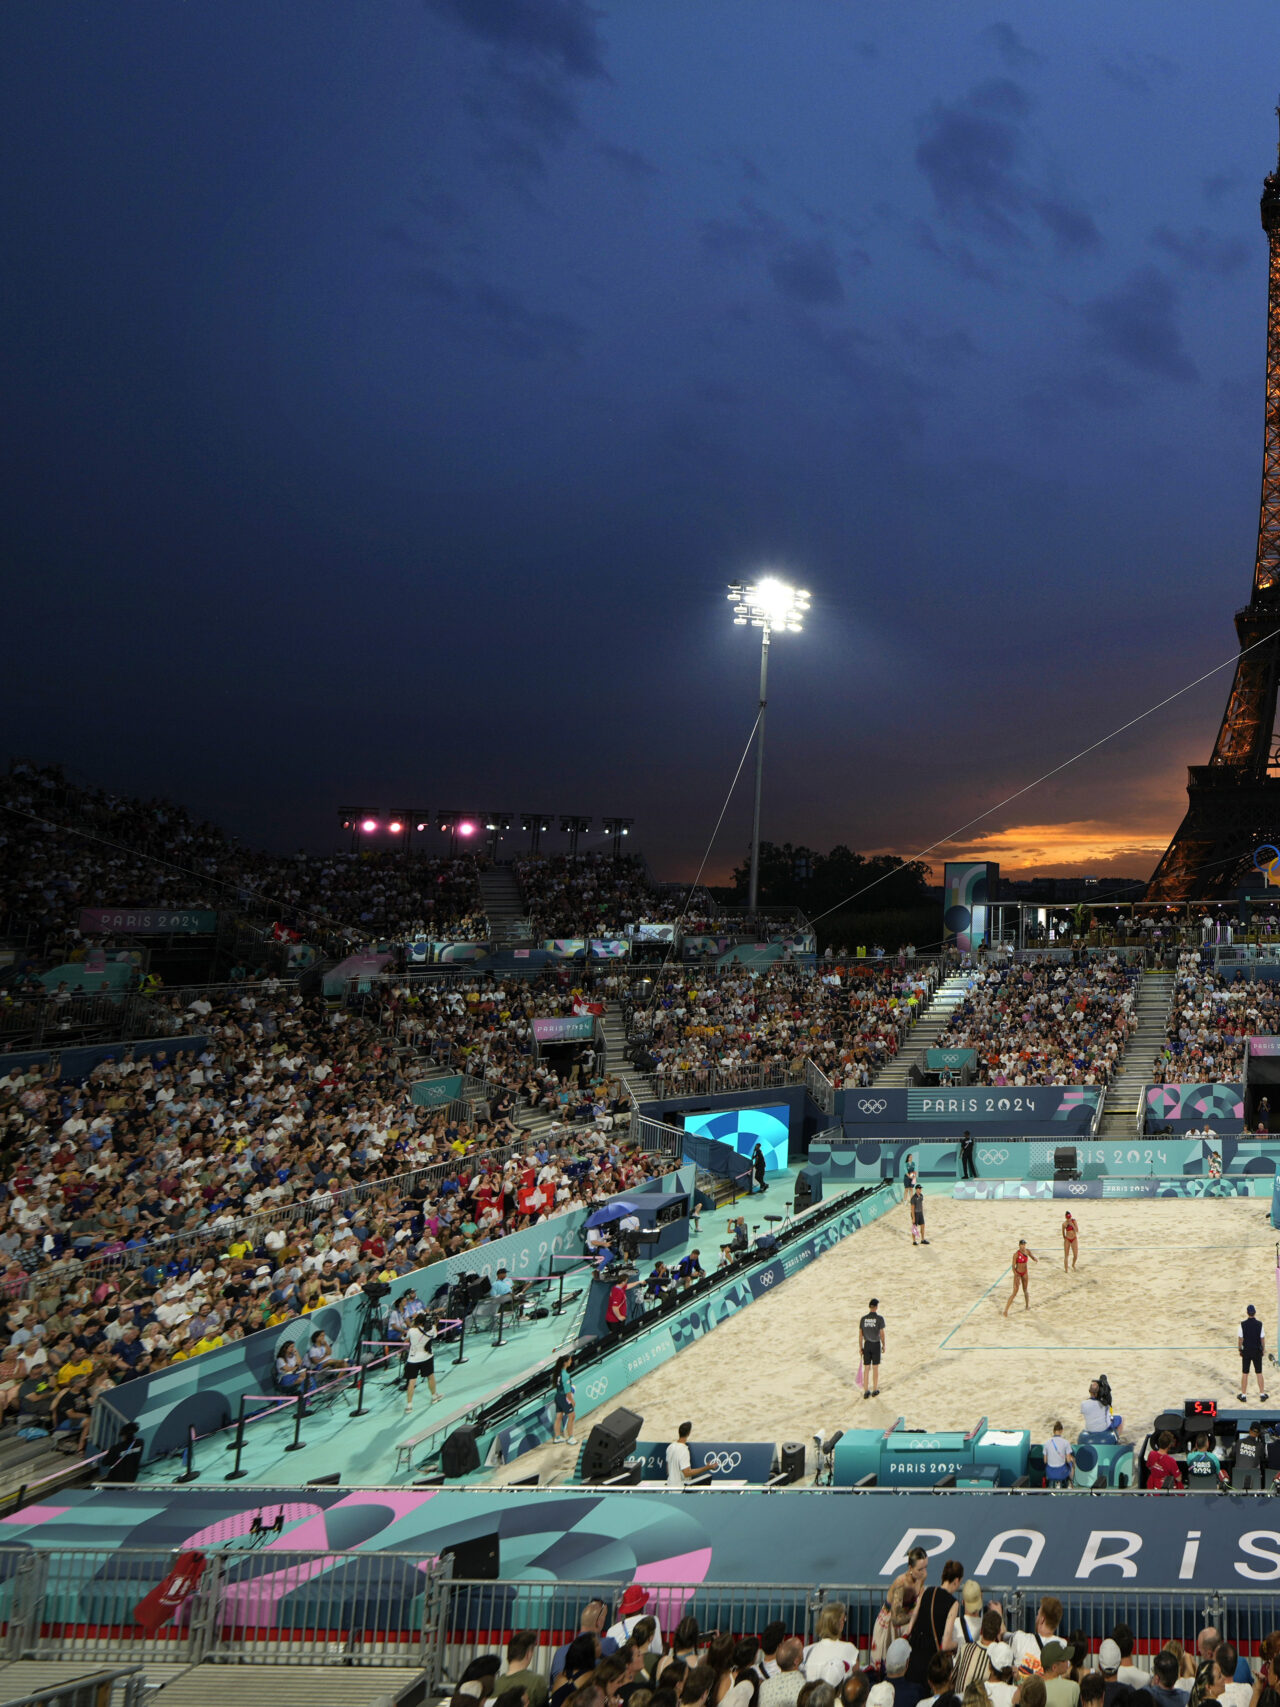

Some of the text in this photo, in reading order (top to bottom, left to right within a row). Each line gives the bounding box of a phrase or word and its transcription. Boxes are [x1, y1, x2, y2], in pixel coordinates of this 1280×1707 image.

[101, 915, 199, 927] PARIS 2024
[922, 1098, 1036, 1112] PARIS 2024
[1046, 1149, 1167, 1164] PRIS 2024
[539, 1230, 575, 1262] 202
[890, 1463, 926, 1473] PARIS
